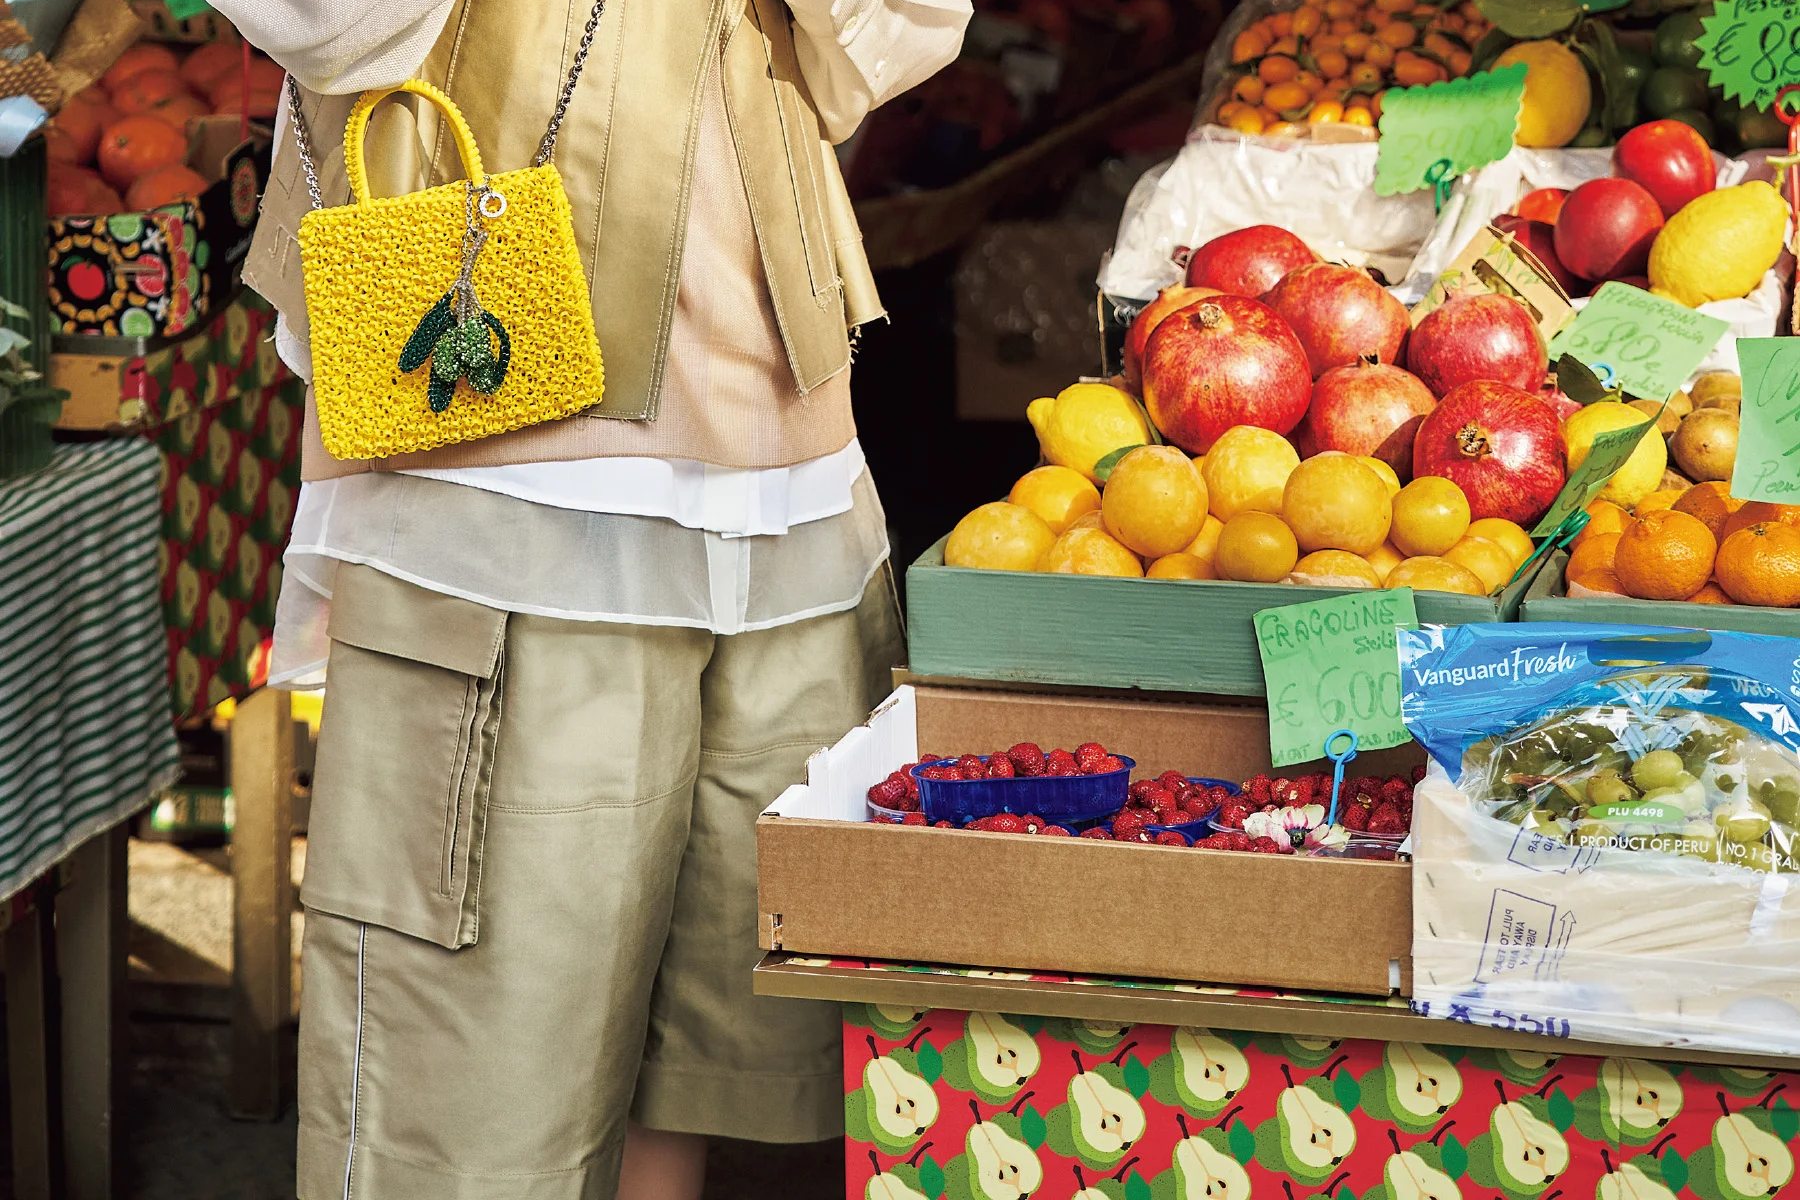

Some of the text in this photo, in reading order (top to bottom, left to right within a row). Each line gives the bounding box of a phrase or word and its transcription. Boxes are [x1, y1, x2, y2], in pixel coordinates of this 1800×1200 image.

[1607, 806, 1664, 818] PLU 4498
[1580, 834, 1649, 851] PRODUCT
[1650, 836, 1670, 852] OF
[1675, 837, 1709, 854] PERU
